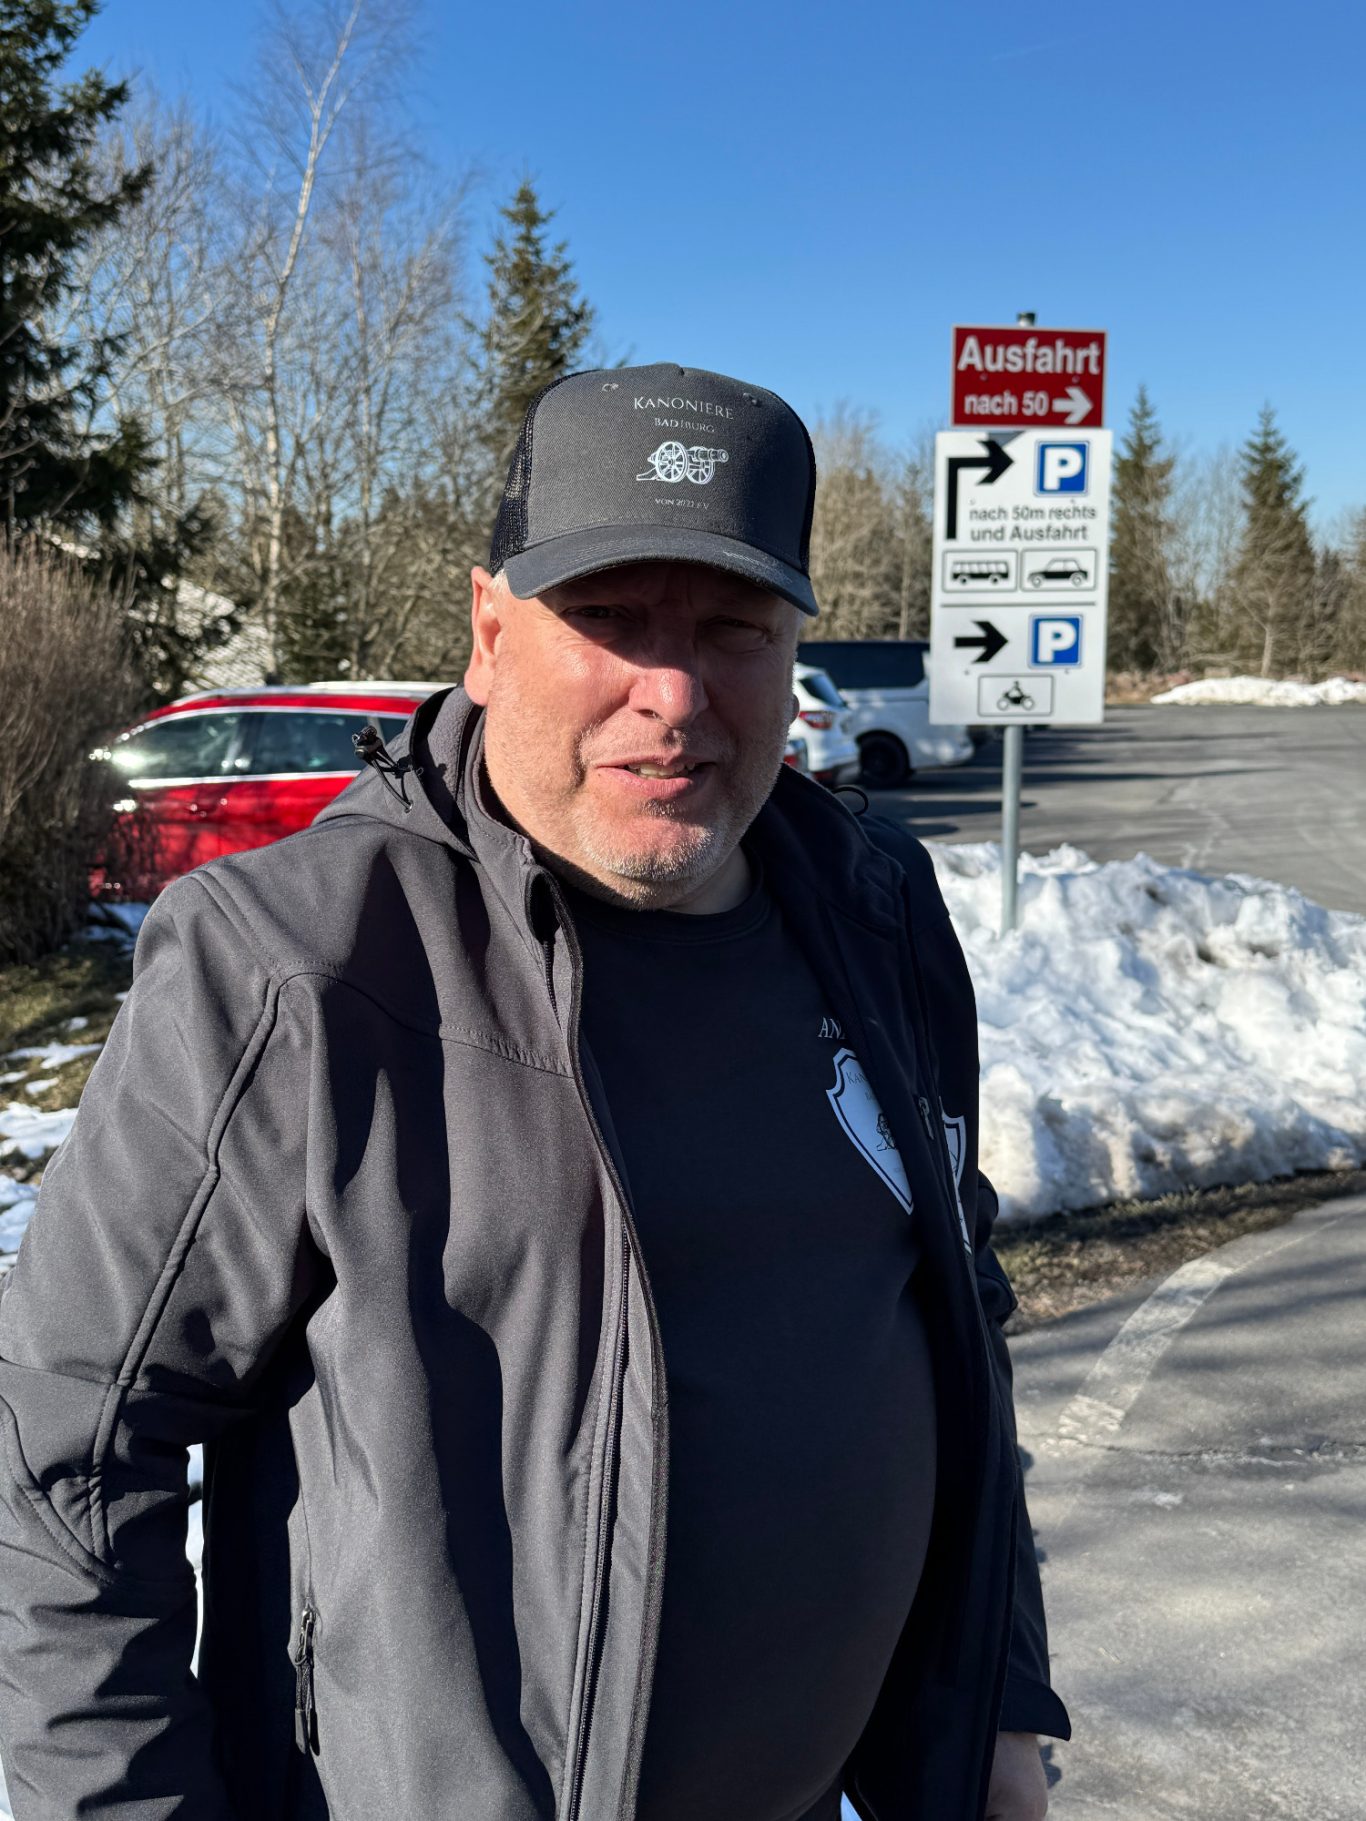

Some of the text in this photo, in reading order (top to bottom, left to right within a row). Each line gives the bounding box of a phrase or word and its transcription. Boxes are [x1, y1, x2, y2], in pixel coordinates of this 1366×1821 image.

[957, 335, 1100, 375] Ausfahrt
[634, 396, 734, 420] KANONIERE
[964, 389, 1049, 416] nach 50
[1044, 447, 1083, 490] P
[969, 504, 1097, 521] nach 50m rechts
[970, 524, 1088, 542] und Ausfahrt
[1037, 620, 1077, 663] P
